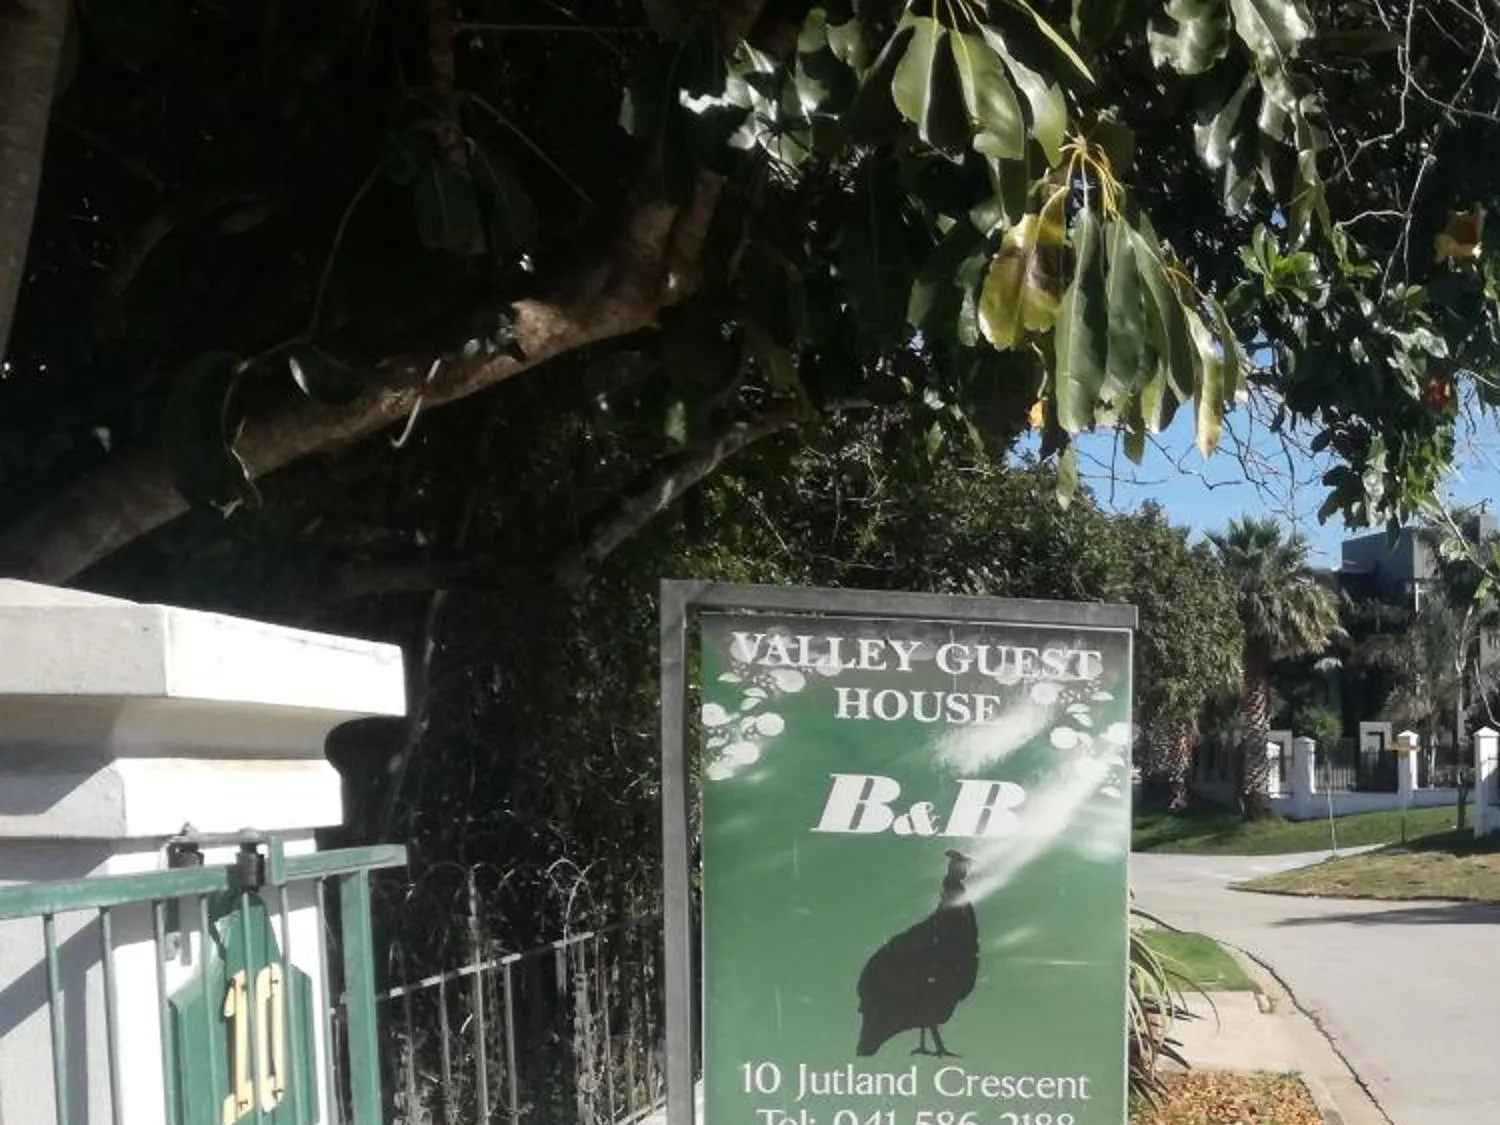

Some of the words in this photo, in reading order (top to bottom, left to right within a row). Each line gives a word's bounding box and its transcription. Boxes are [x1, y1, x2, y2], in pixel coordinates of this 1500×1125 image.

[731, 631, 922, 672] VALLEY
[935, 642, 1103, 681] GUEST
[834, 687, 1001, 725] HOUSE
[742, 1061, 781, 1095] 10
[796, 1063, 917, 1101] Jutland
[933, 1065, 1091, 1100] Crescent
